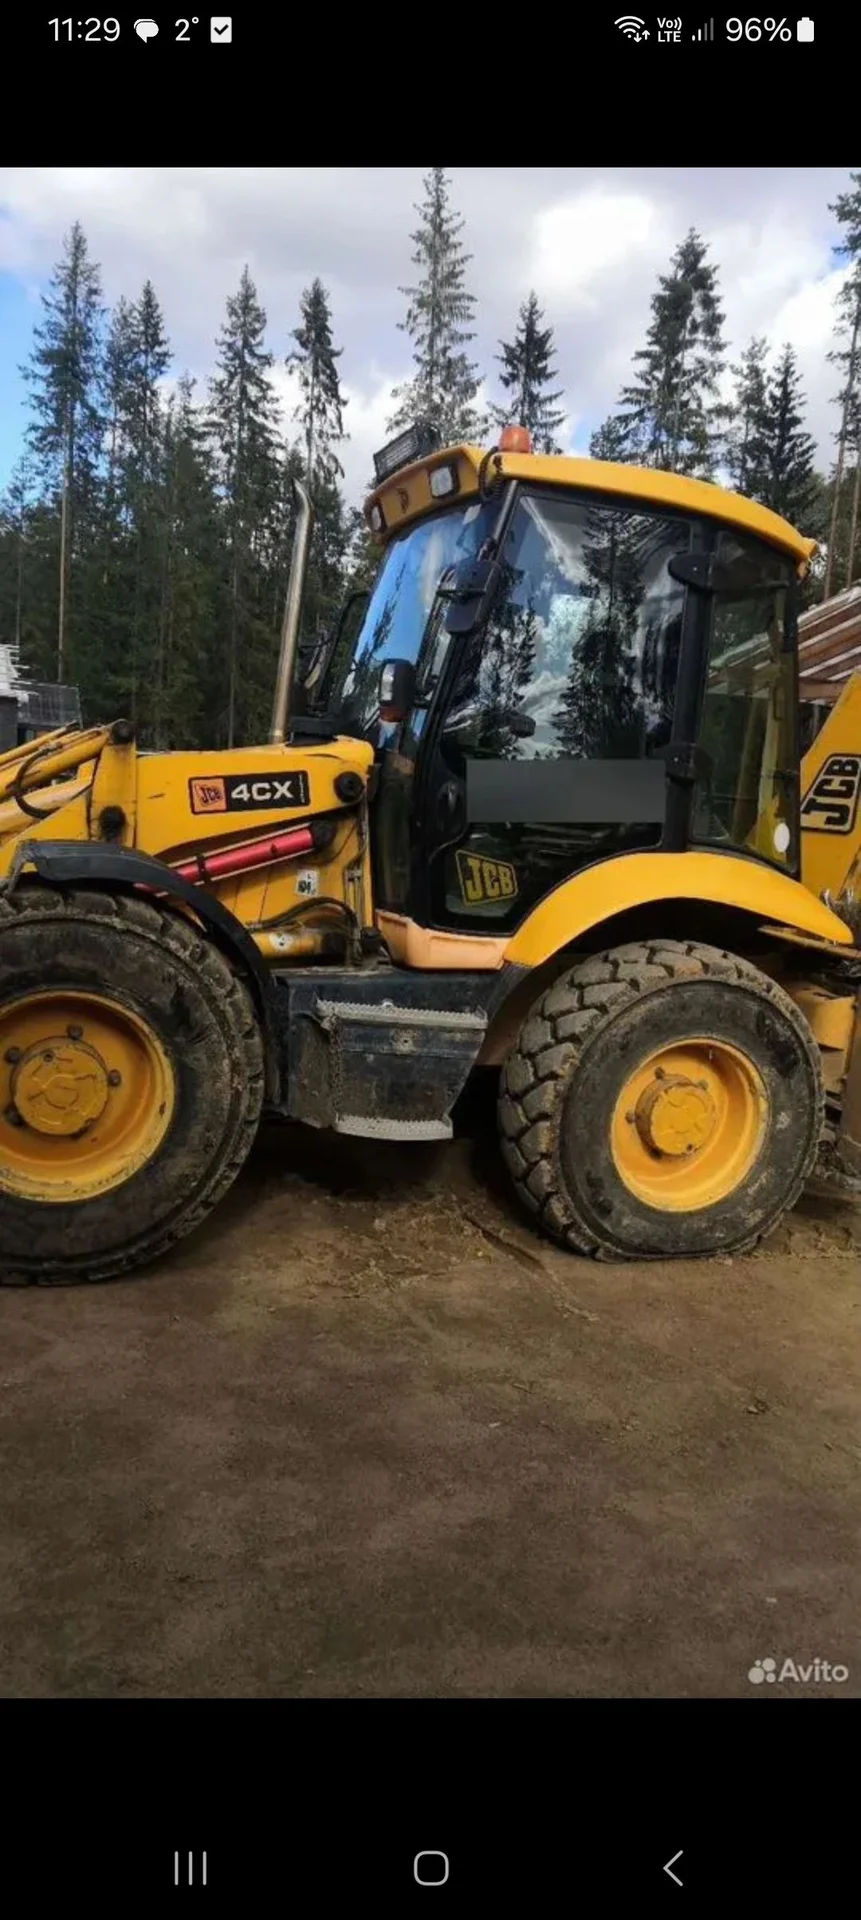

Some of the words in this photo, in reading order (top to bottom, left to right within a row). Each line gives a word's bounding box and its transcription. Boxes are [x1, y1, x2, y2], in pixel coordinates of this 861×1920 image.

[231, 780, 294, 802] 4CX
[800, 759, 860, 826] JCB
[465, 857, 514, 900] JCB
